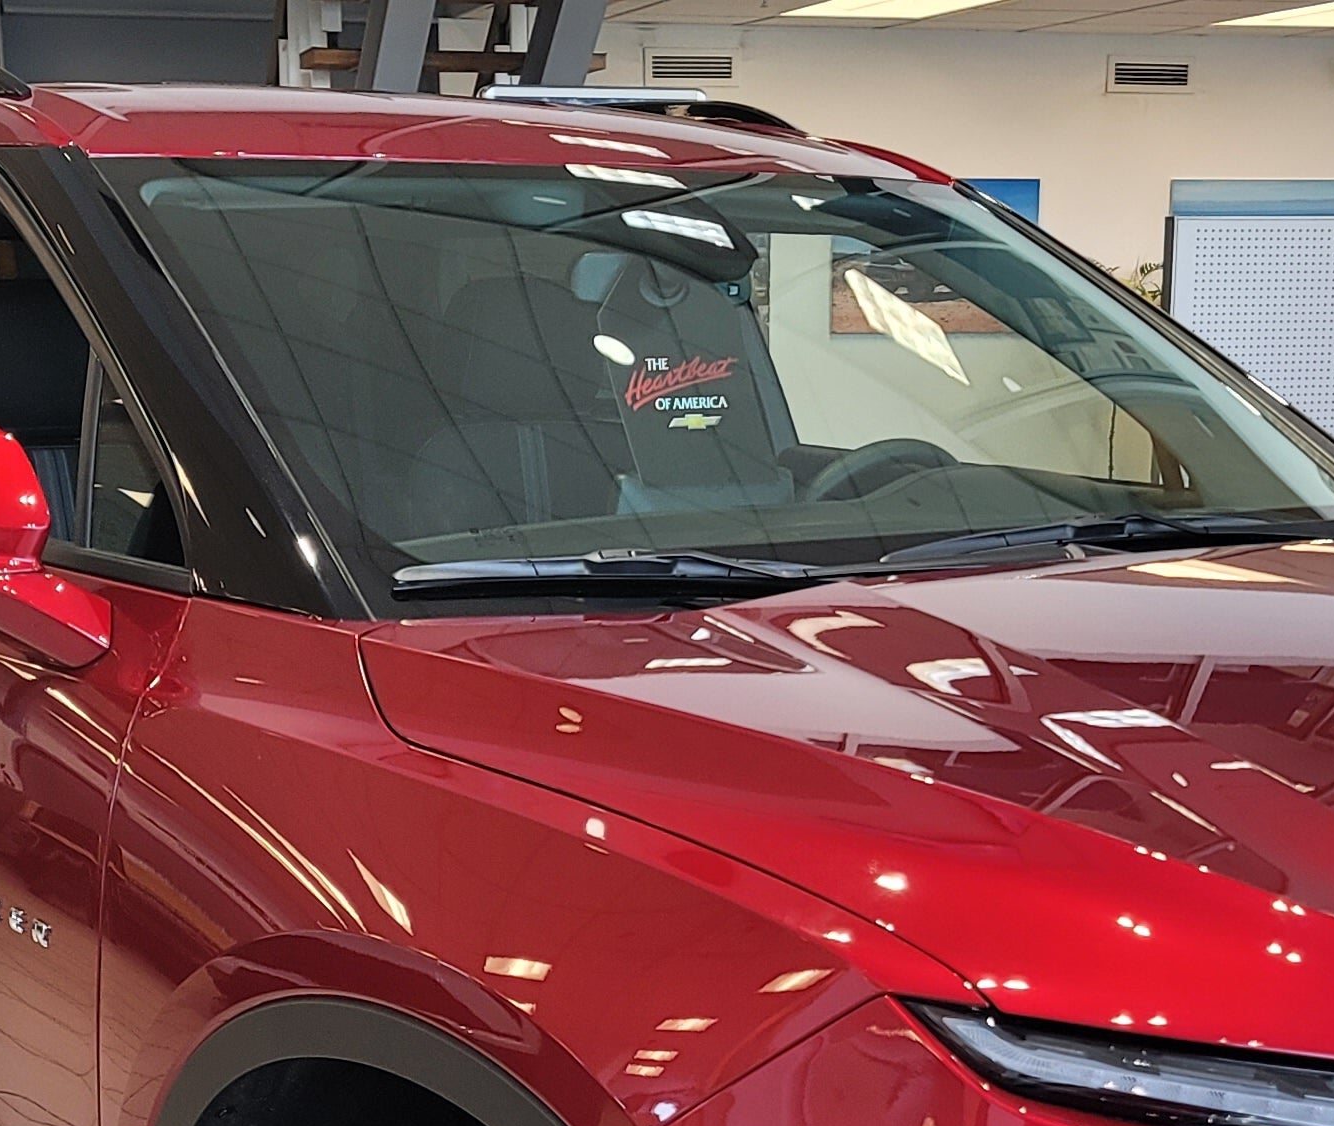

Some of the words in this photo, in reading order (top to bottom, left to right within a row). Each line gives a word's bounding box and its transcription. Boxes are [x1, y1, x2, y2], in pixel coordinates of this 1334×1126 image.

[645, 357, 670, 371] THE
[624, 356, 739, 411] Heartbeat
[654, 397, 671, 411] OF
[672, 395, 728, 410] AMERICA
